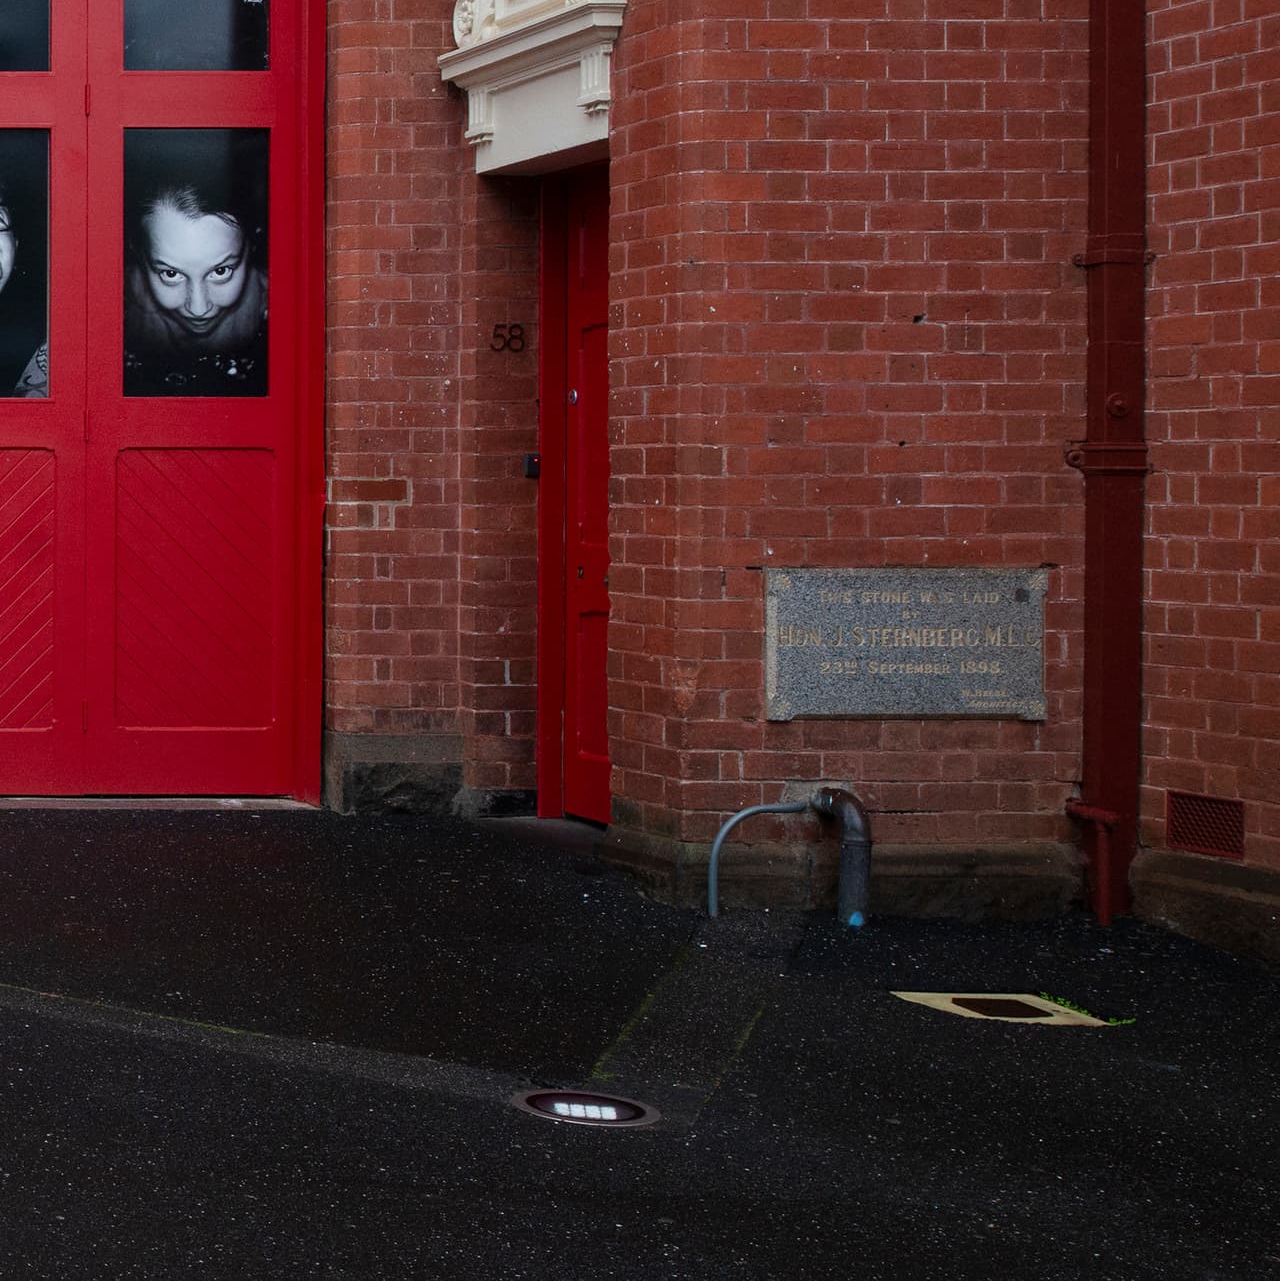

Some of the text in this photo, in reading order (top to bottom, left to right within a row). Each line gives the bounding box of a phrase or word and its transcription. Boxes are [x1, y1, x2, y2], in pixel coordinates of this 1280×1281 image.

[490, 324, 525, 352] 58
[818, 590, 852, 604] THIS
[861, 590, 911, 604] STONE
[962, 590, 1000, 604] LAID
[850, 623, 980, 647] STERNBERG
